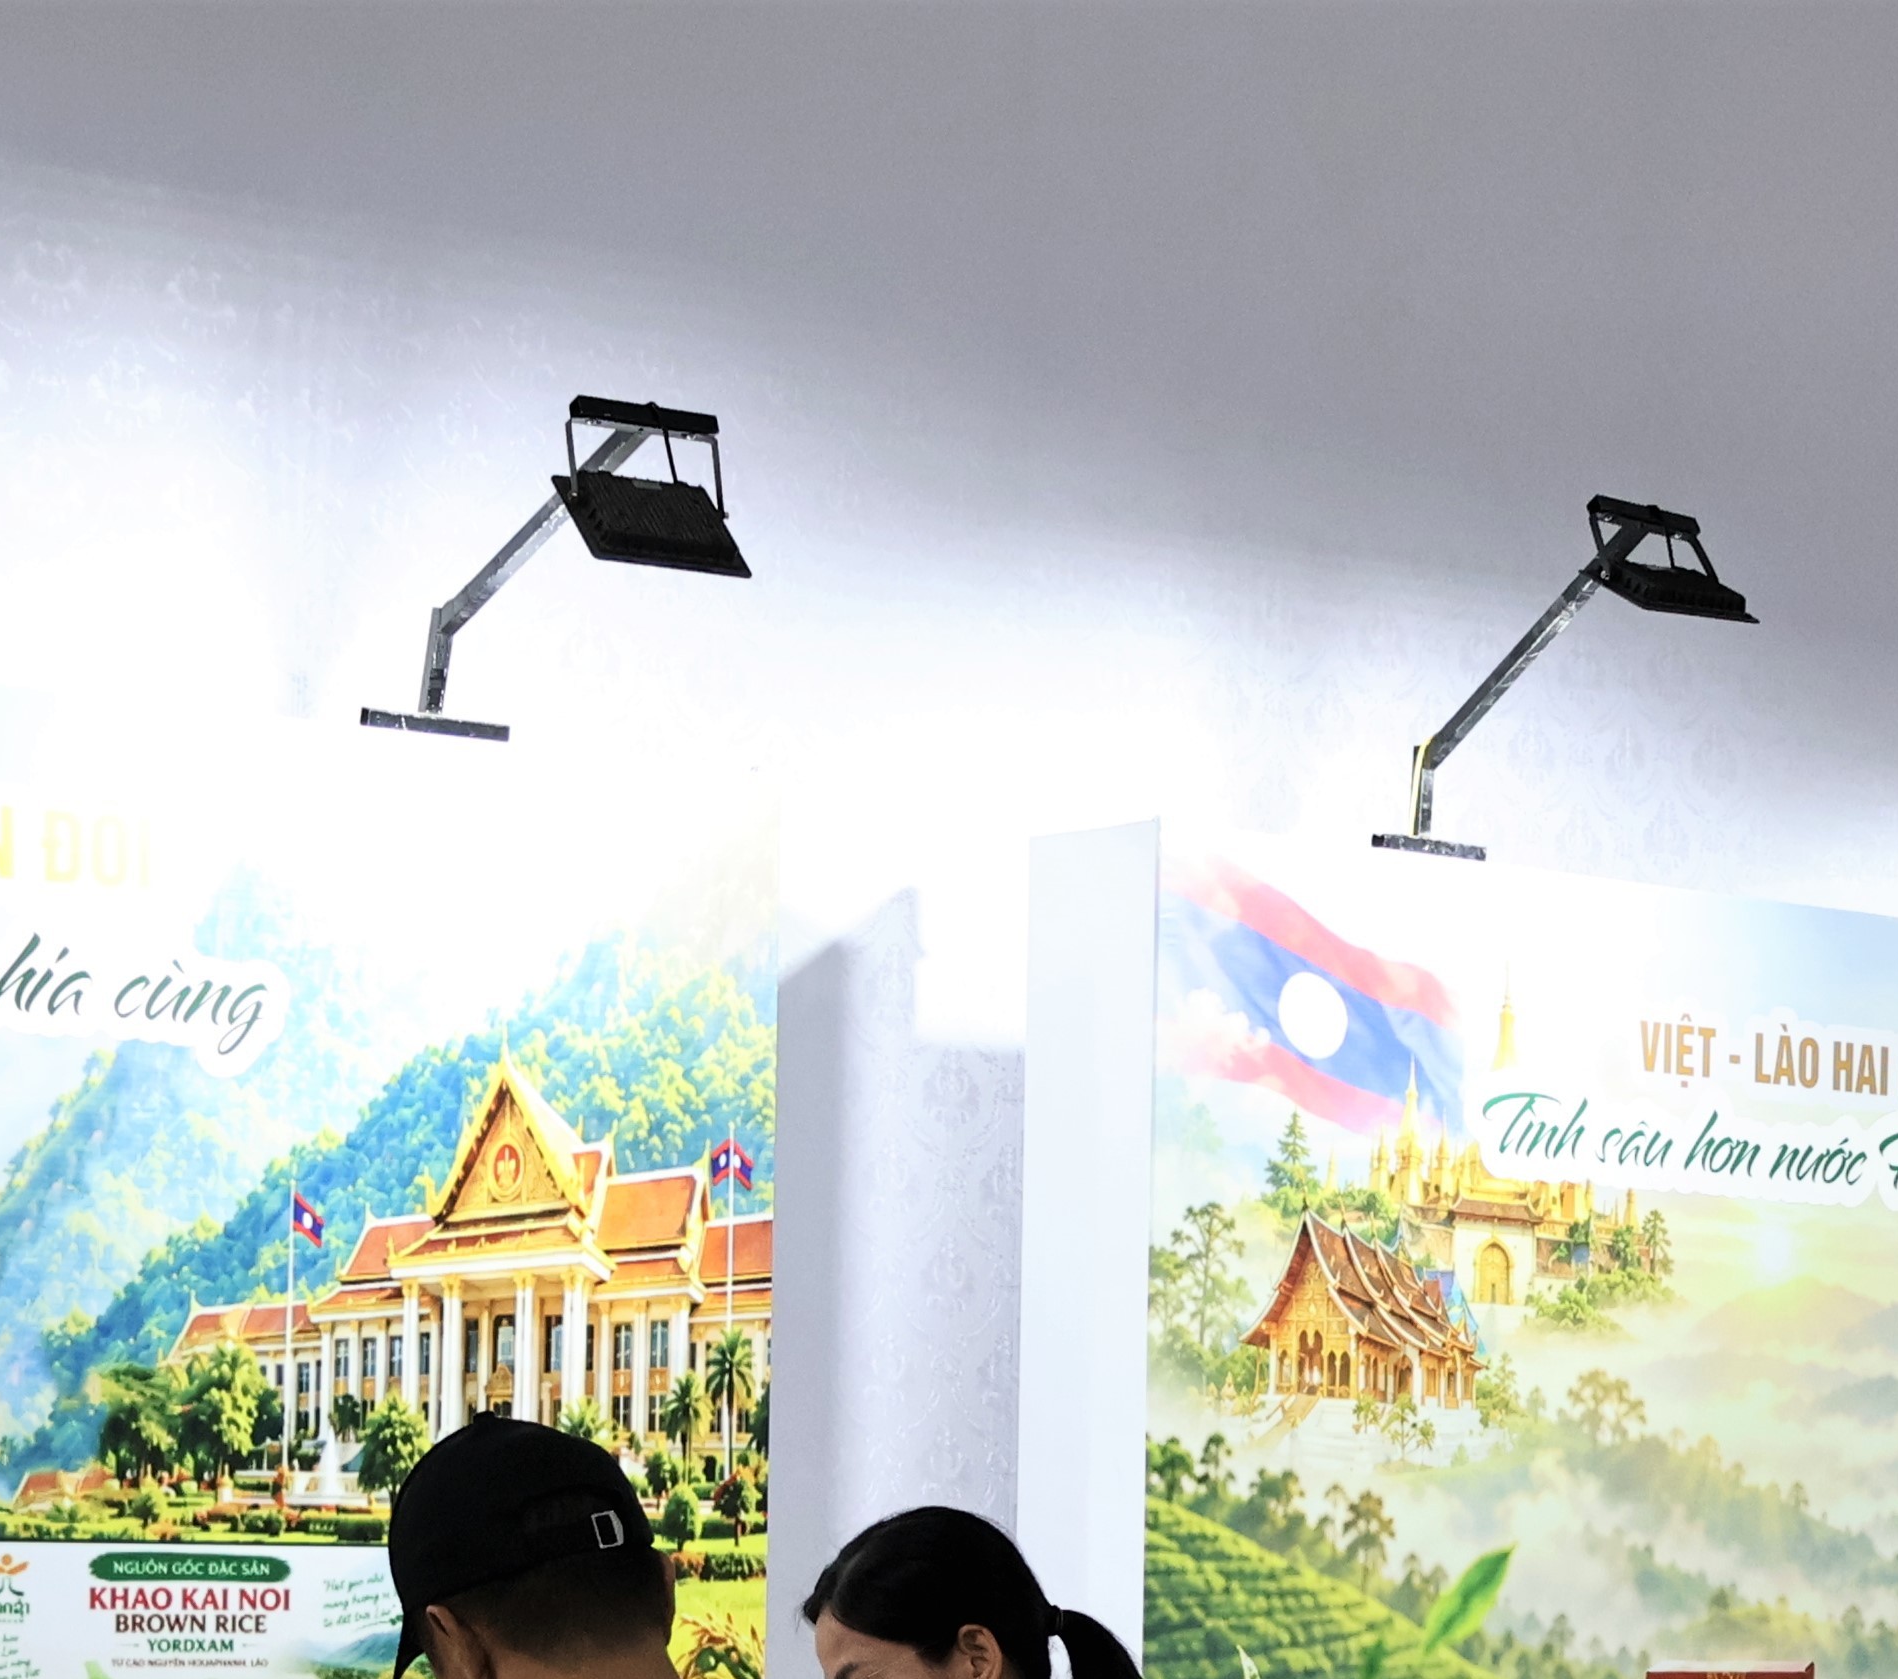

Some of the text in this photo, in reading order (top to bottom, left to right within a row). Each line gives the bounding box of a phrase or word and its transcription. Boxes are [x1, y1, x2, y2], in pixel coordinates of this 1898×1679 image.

[114, 958, 269, 1054] cùng
[1639, 1014, 1718, 1089] VIỆT
[1754, 1022, 1820, 1089] LÀO
[1833, 1041, 1889, 1097] HAI
[1483, 1091, 1588, 1161] Tình
[1595, 1120, 1673, 1167] sâu
[1685, 1112, 1760, 1175] hơn
[1771, 1136, 1869, 1187] nước
[89, 1587, 291, 1611] KHAO KAI NOI
[115, 1613, 268, 1634] BROWN RICE
[147, 1639, 234, 1653] YORDXAM
